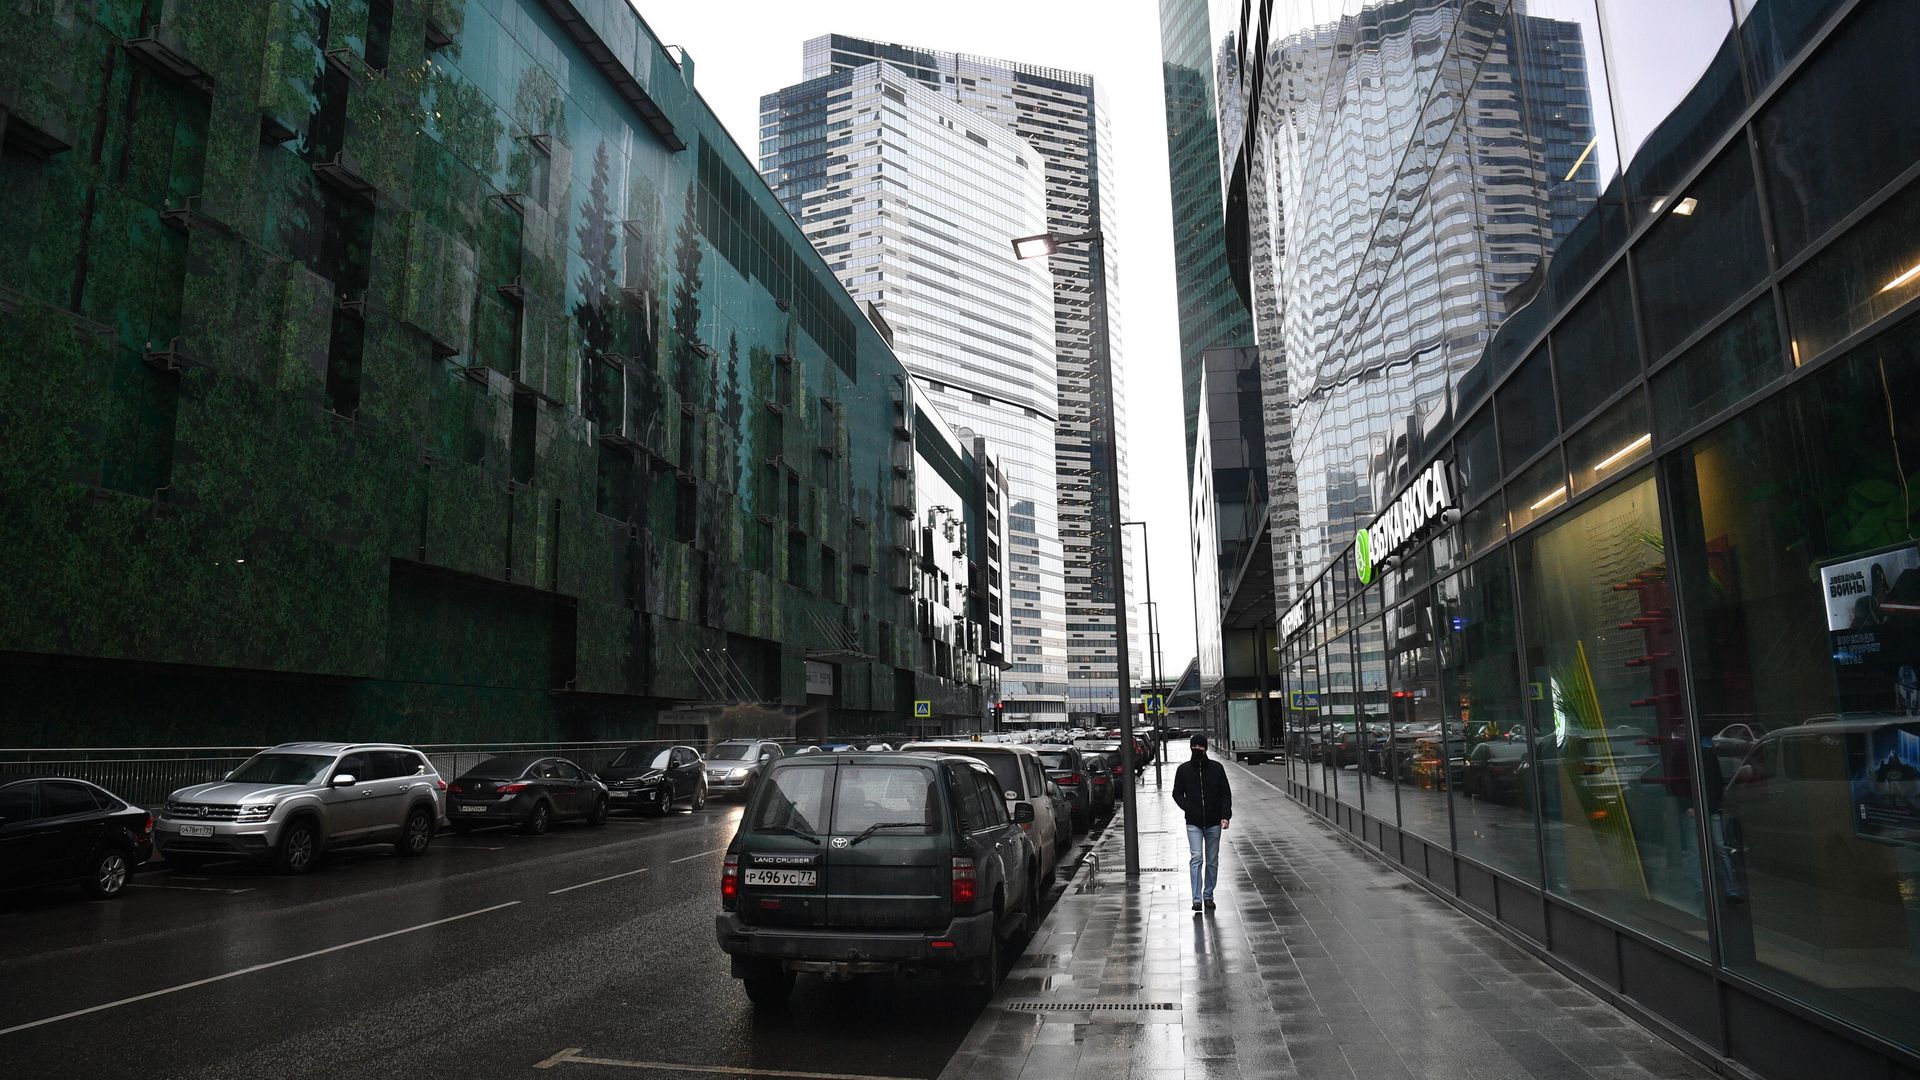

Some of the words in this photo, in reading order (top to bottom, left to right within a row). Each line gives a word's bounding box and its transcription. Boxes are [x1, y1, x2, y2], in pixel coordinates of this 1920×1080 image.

[1368, 502, 1405, 569] АЗБУКА
[1401, 460, 1449, 538] ВКУСА
[801, 871, 813, 882] 77
